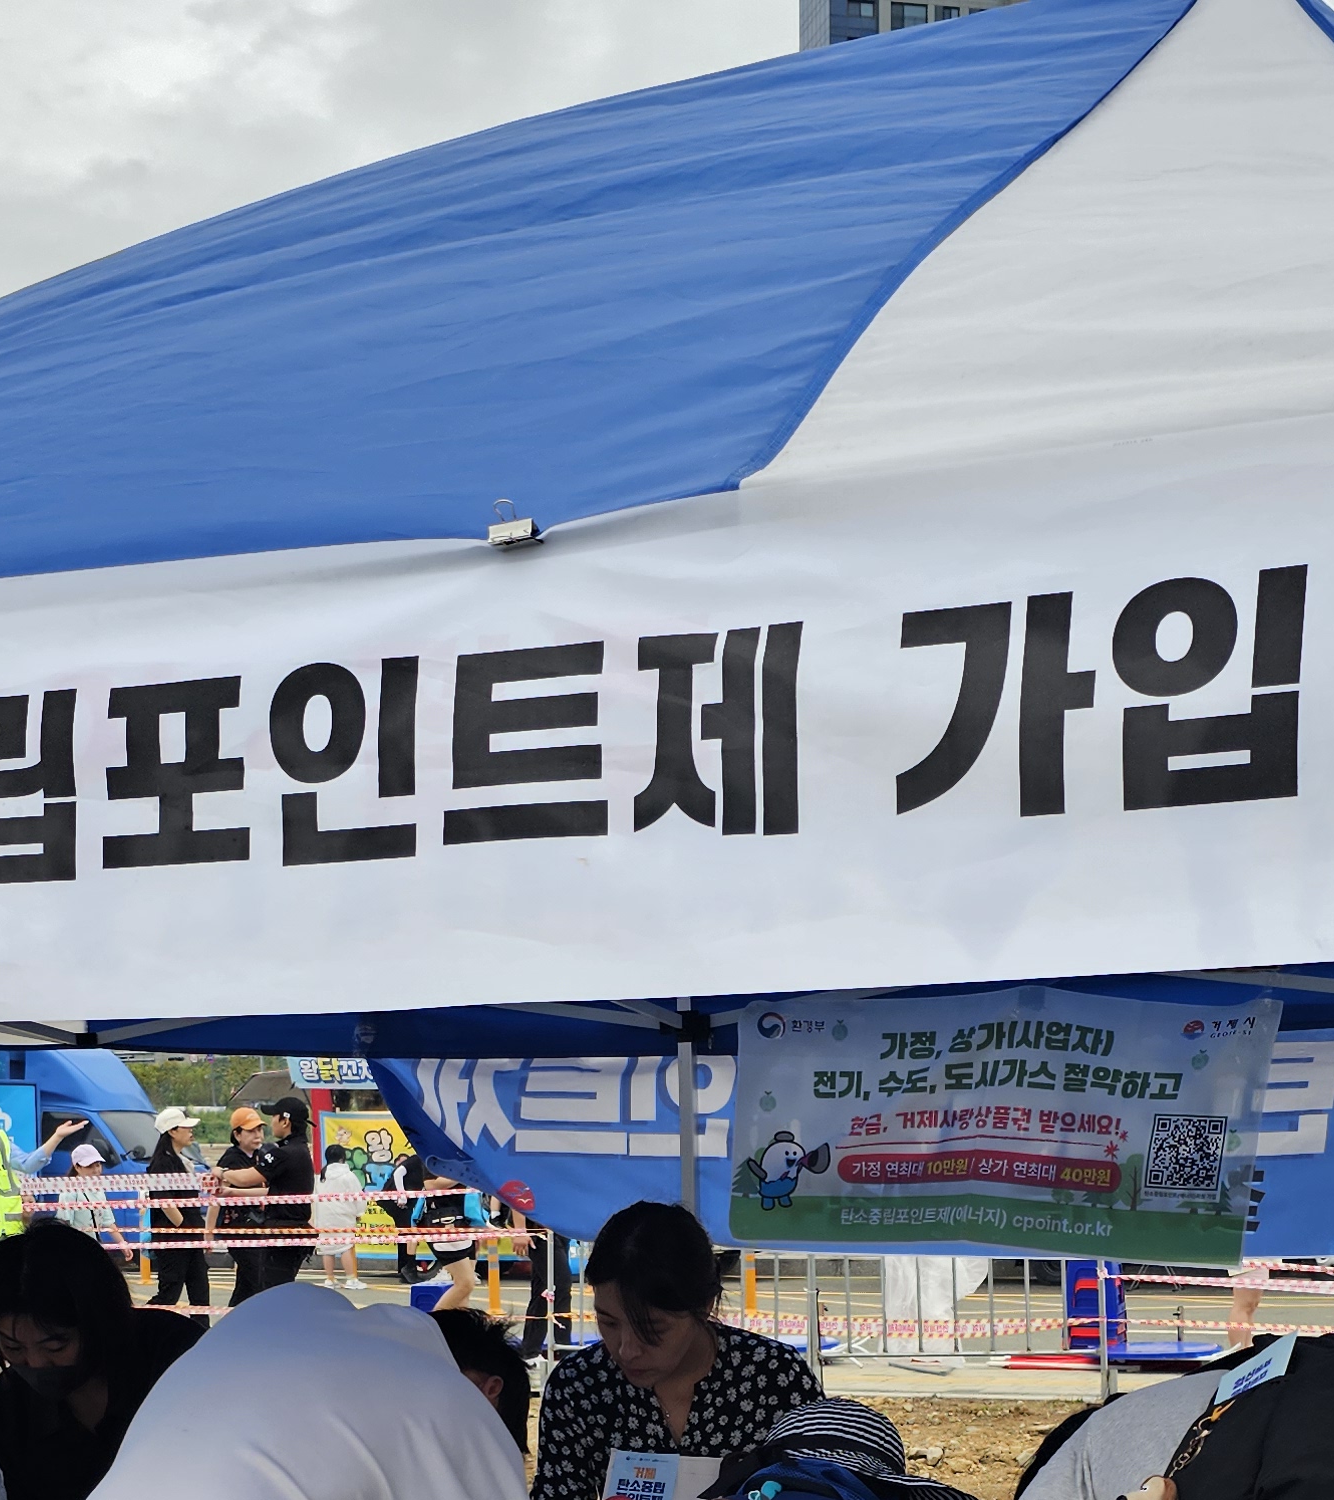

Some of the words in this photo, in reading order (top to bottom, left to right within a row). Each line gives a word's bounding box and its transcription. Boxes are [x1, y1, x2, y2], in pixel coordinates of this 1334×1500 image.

[895, 563, 1309, 817] 가입
[790, 1019, 826, 1033] 환경부
[879, 1031, 943, 1060] 가정,
[948, 1019, 1116, 1057] 상가(사업자)
[813, 1070, 870, 1101] 전기,
[878, 1066, 936, 1097] 수도,
[943, 1058, 1057, 1091] 도시가스
[1062, 1062, 1183, 1100] 절약하고
[848, 1114, 888, 1136] 현금,
[895, 1105, 1032, 1131] 거제사랑상품권
[1038, 1109, 1123, 1137] 받으세요!
[852, 1162, 881, 1178] 가정
[886, 1161, 924, 1177] 연최대
[978, 1159, 1009, 1177] 상가
[1013, 1162, 1057, 1182] 연최대
[1060, 1167, 1112, 1187] 40만원
[1011, 1213, 1114, 1238] cpoint.or.kr
